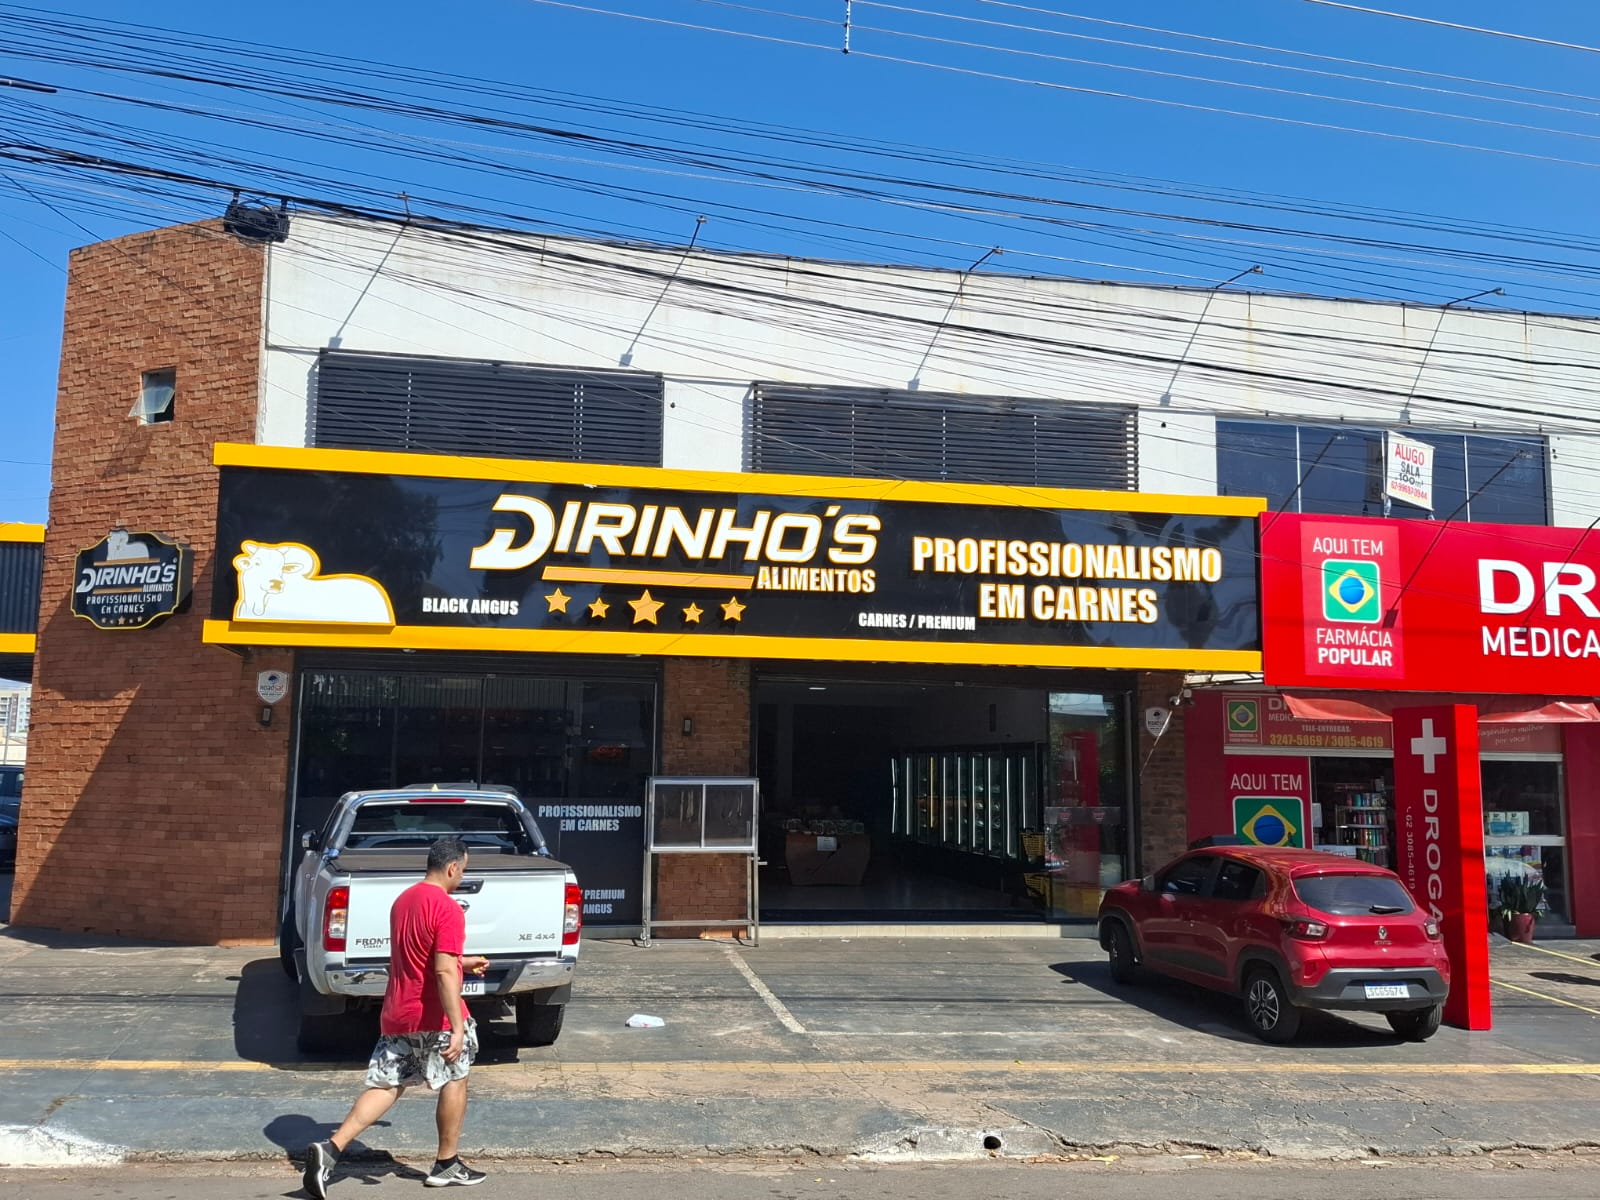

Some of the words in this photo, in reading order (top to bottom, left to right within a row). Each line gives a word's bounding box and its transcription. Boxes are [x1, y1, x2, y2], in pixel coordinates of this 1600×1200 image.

[1395, 443, 1425, 466] ALUGO
[1400, 461, 1420, 478] SALA
[469, 493, 882, 571] DIRINHO'S
[1312, 537, 1349, 555] AQUI
[1351, 538, 1384, 556] TEM
[911, 536, 1223, 583] PROFISSIONALISMO
[756, 565, 876, 594] ALIMENTOS
[86, 593, 162, 605] PROFISSIONALISMO
[422, 597, 467, 614] BLACK
[470, 600, 519, 616] ANGUS
[979, 583, 1025, 620] EM
[1031, 584, 1158, 623] CARNES
[101, 605, 112, 614] EM
[113, 604, 145, 613] CARNES
[858, 612, 907, 628] CARNES
[908, 613, 915, 629] /
[918, 615, 976, 631] PREMIUM
[1316, 627, 1393, 648] FARMÁCIA
[1318, 647, 1393, 667] POPULAR
[1231, 773, 1266, 791] AQUI
[1271, 774, 1303, 791] TEM
[538, 805, 641, 817] PROFISSIONALISMO
[560, 819, 575, 831] EM
[577, 819, 620, 831] CARNES
[1423, 788, 1444, 923] DROGA
[584, 889, 625, 900] PREMIUM
[582, 903, 613, 914] ANGUS
[355, 937, 391, 945] FRONT
[518, 933, 534, 941] XE
